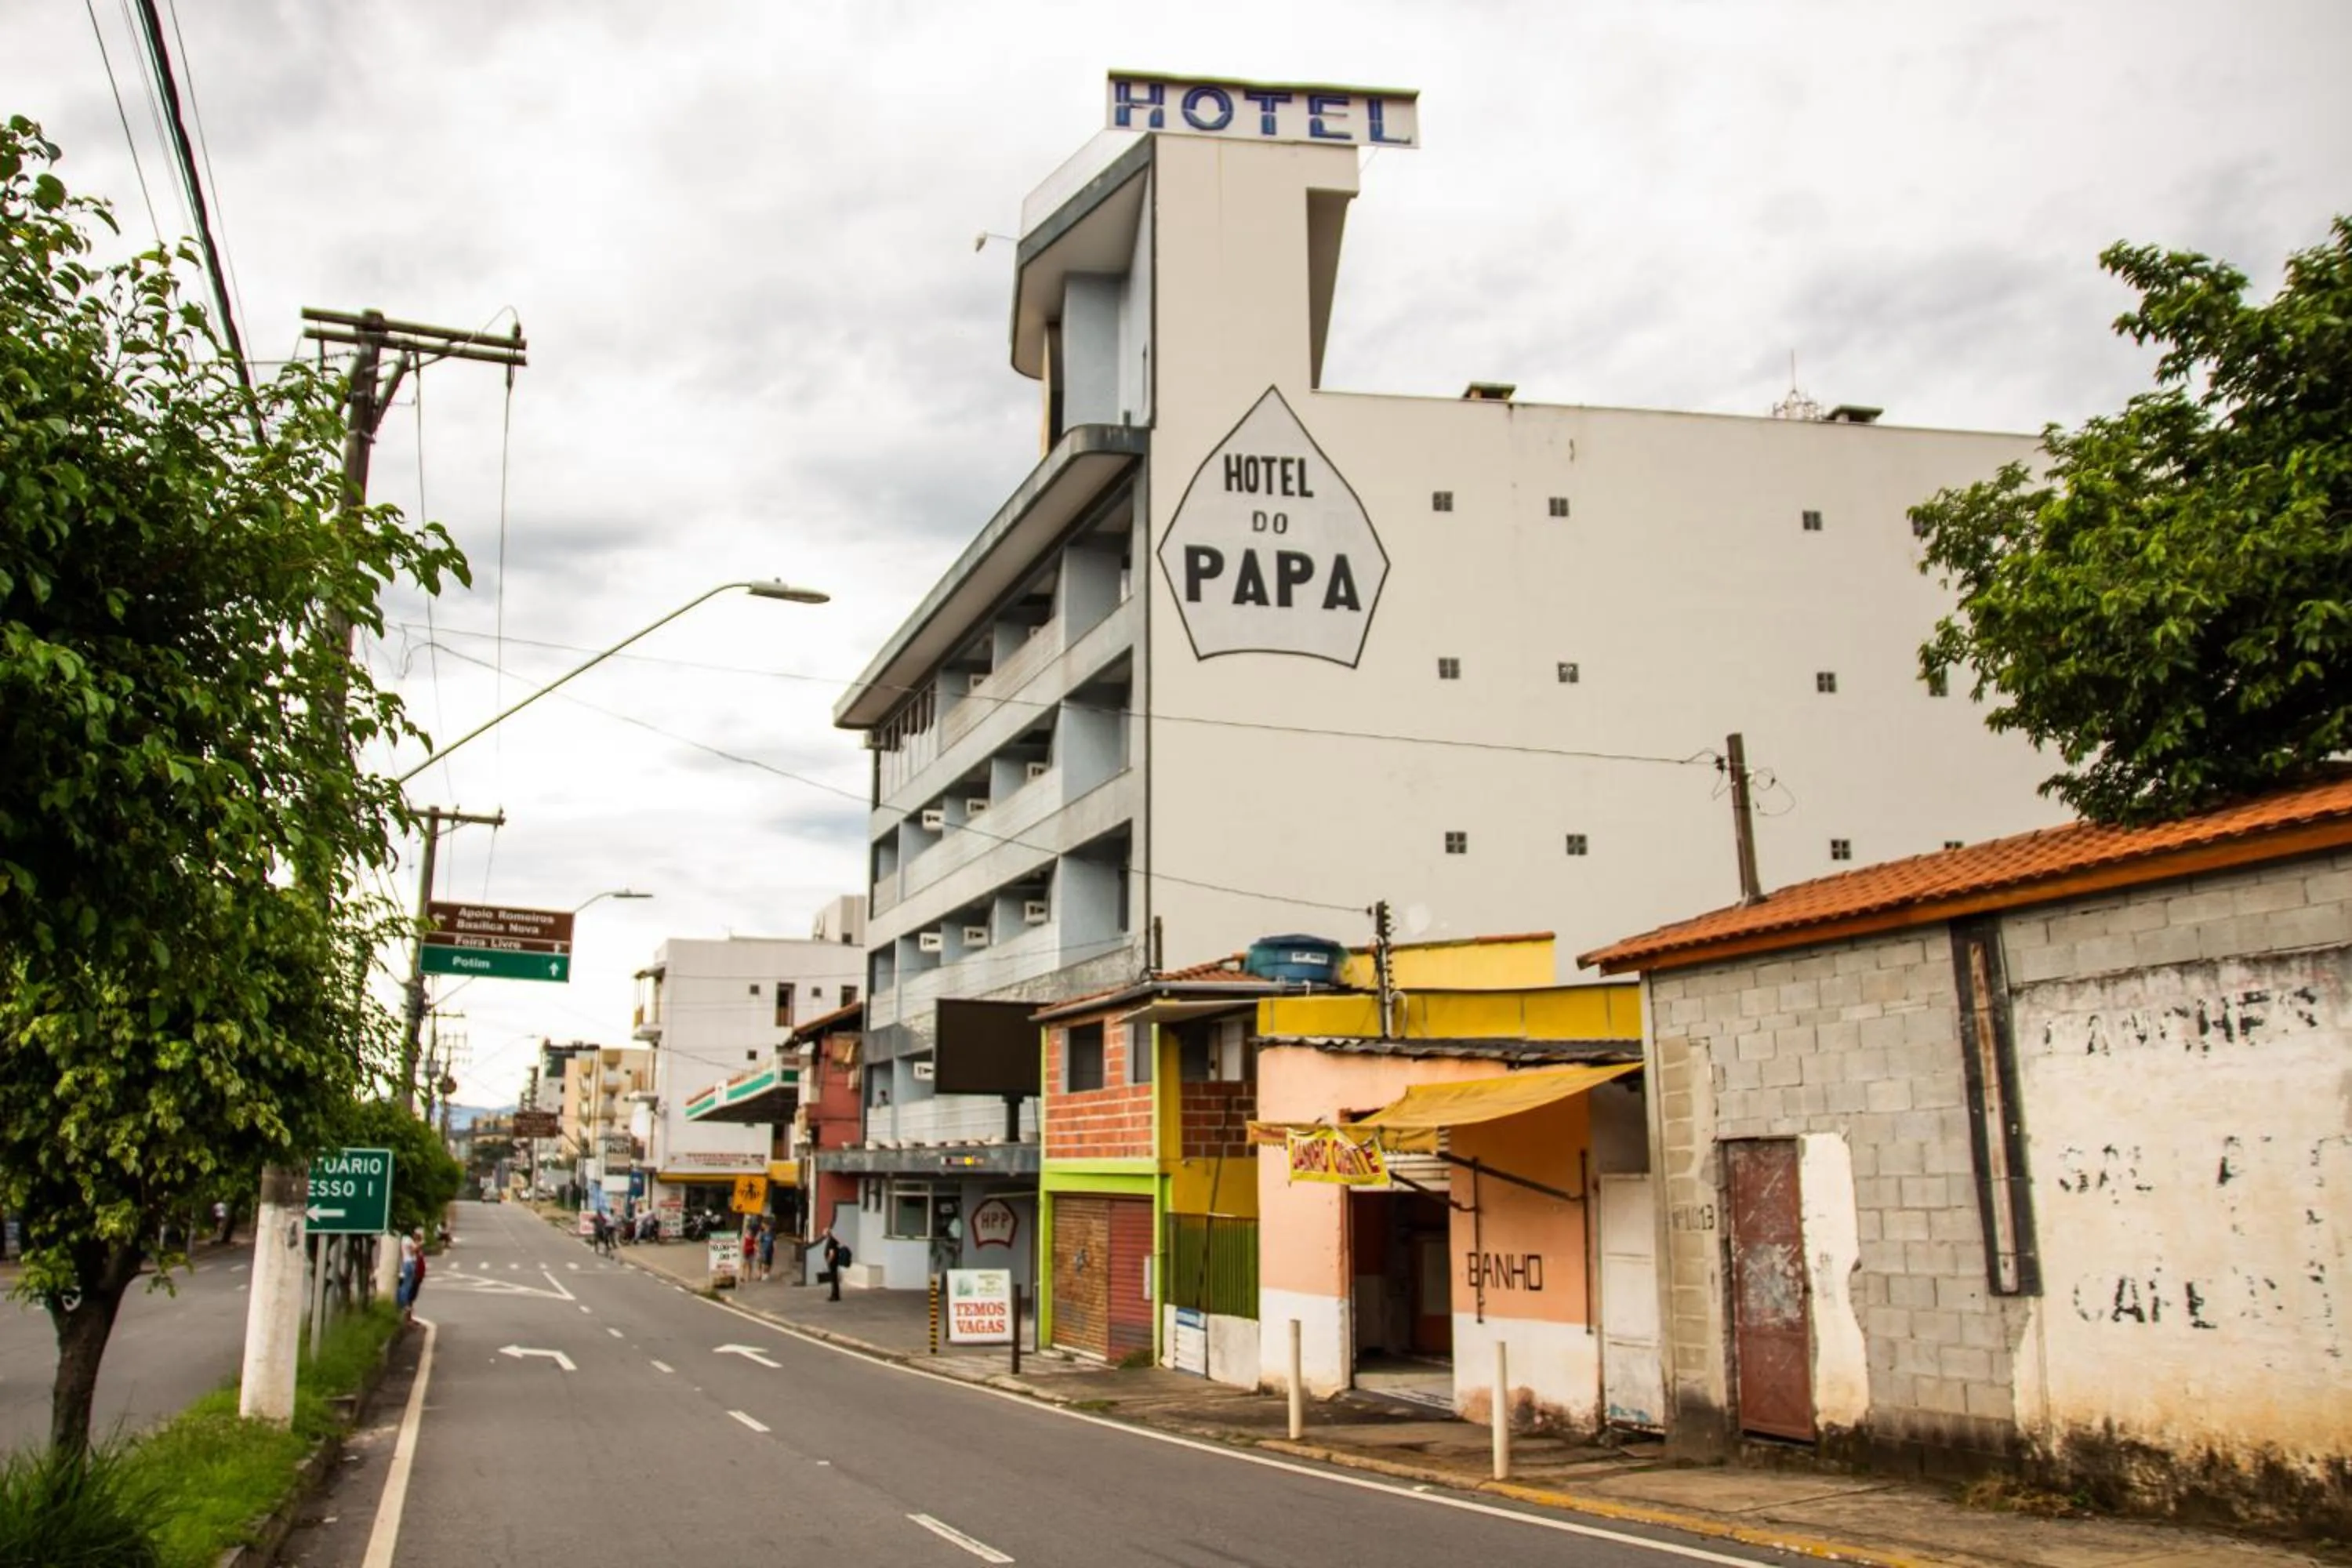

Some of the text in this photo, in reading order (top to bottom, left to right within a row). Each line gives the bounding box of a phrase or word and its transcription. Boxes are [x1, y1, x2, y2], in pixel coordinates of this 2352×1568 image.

[1114, 81, 1412, 145] HOTEL
[1224, 453, 1315, 499] HOTEL
[1252, 510, 1289, 535] DO
[1184, 543, 1363, 612] PAPA
[458, 906, 555, 924] Apoio Romeiros
[509, 923, 539, 935] Nova
[452, 955, 491, 969] Potim
[307, 1179, 356, 1198] ESSO
[981, 1211, 1010, 1229] HPP
[1467, 1252, 1543, 1292] BANHO
[953, 1301, 1007, 1317] TEMOS
[955, 1319, 1006, 1334] VAGAS
